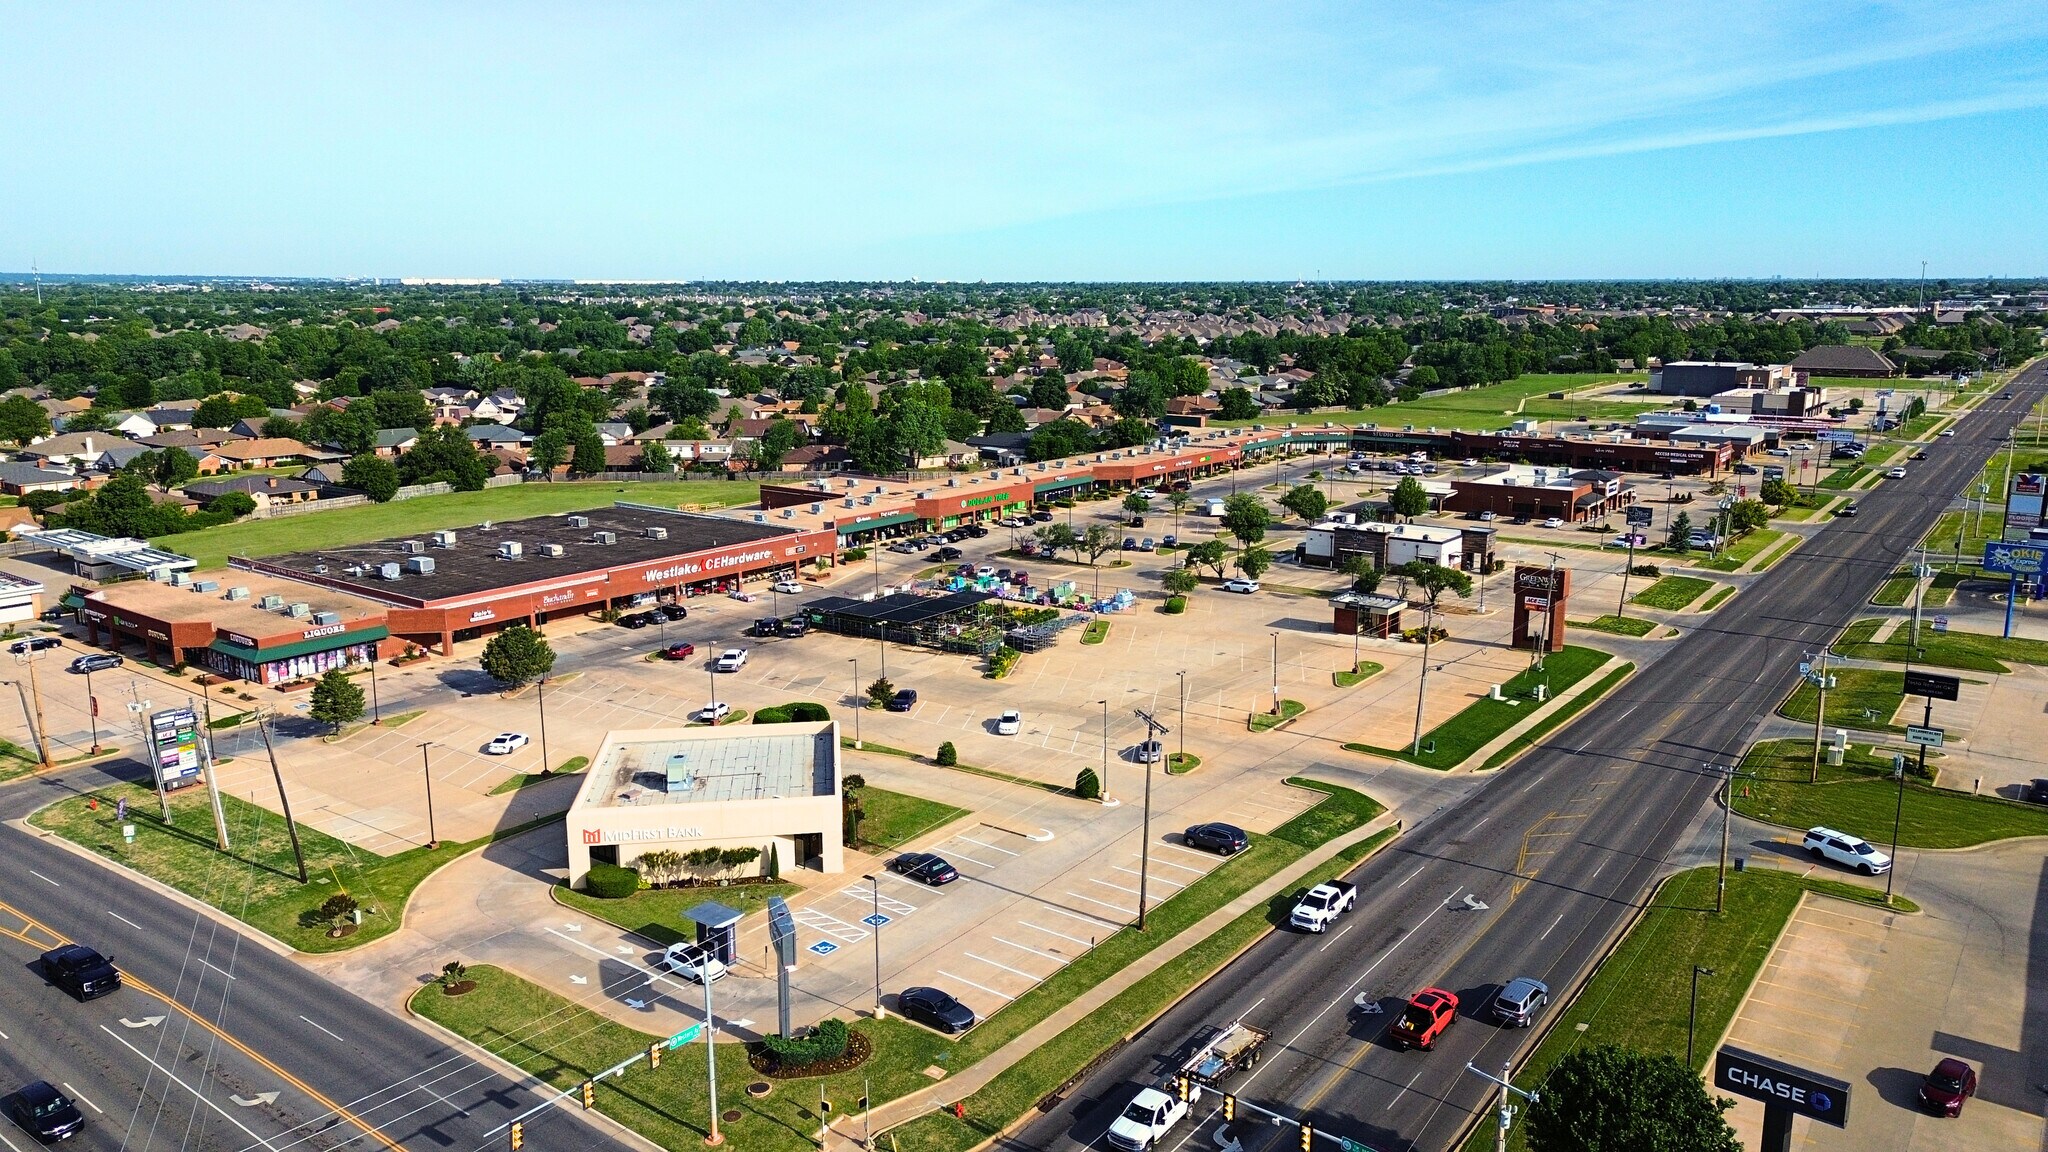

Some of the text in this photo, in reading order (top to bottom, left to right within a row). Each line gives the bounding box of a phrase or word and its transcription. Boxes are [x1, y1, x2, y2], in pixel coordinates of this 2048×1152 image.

[967, 493, 1010, 507] DOLLAR TREE
[2011, 548, 2043, 560] OKIE
[646, 564, 700, 582] Westlake
[720, 551, 770, 567] Hardware
[303, 624, 346, 639] LIQUORS
[666, 826, 703, 839] BANK
[1728, 1067, 1806, 1104] CHASE
